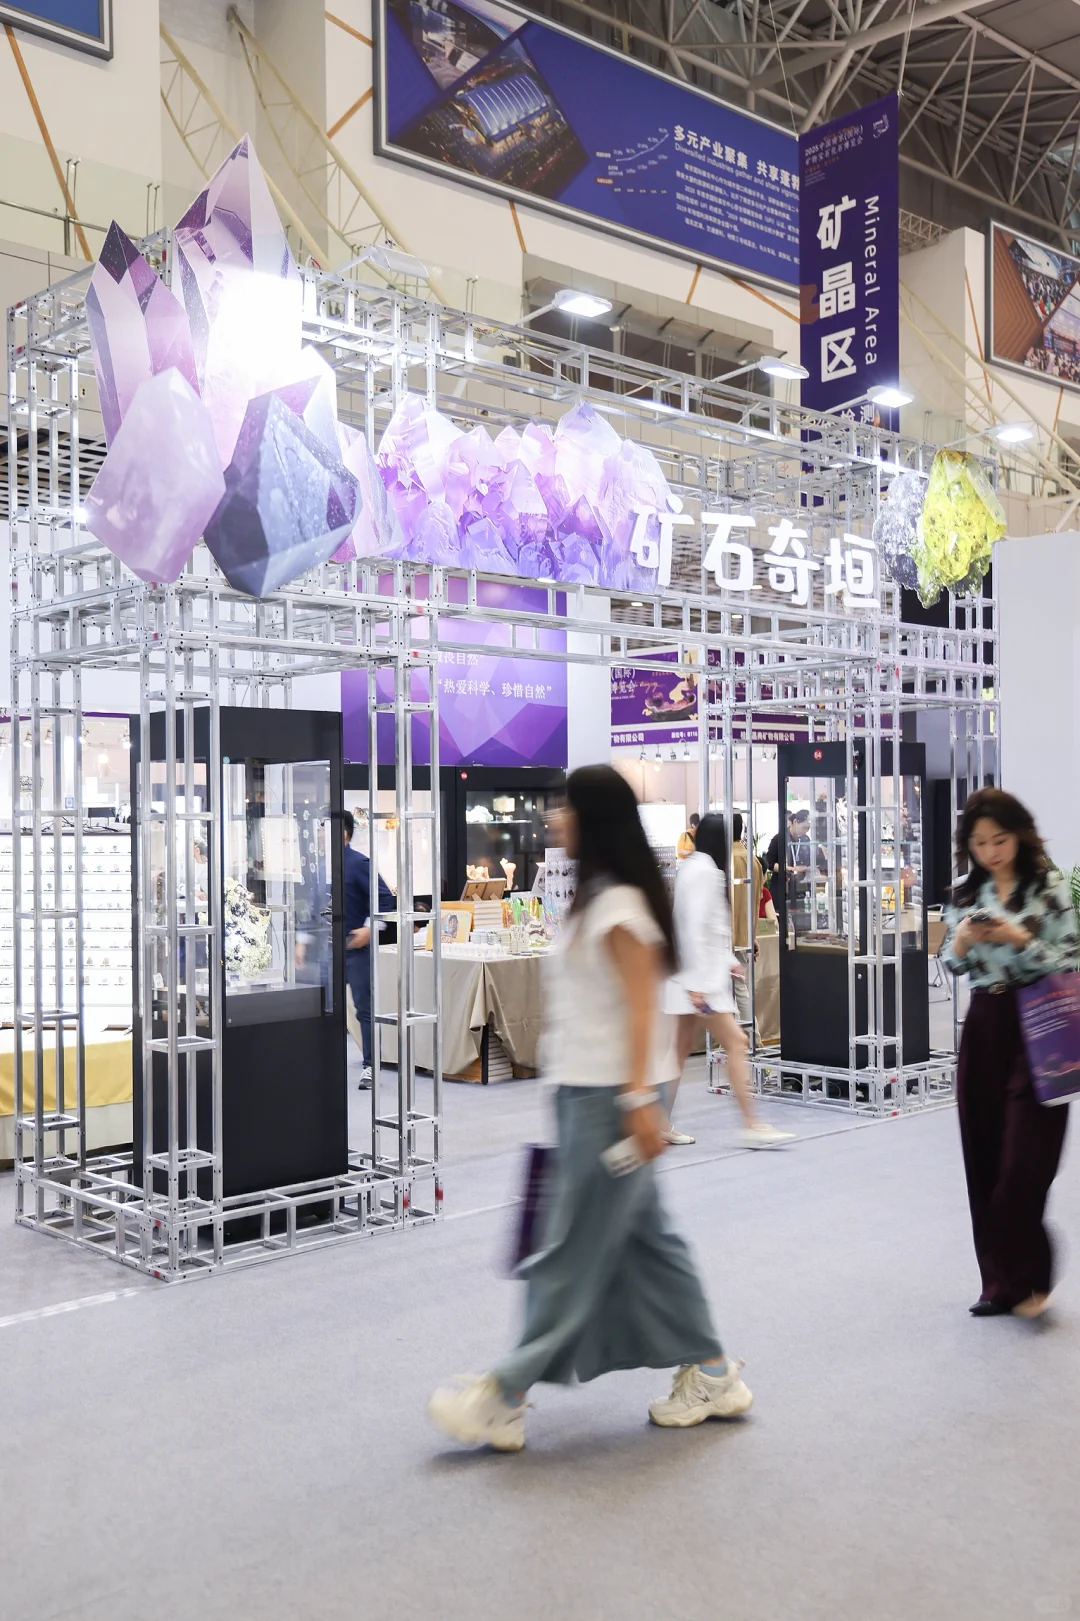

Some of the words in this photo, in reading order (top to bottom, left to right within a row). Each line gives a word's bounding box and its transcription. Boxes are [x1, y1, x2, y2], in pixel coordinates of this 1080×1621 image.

[674, 125, 747, 169] 多元产业聚集
[816, 195, 857, 383] 矿晶区
[864, 195, 881, 296] Mineral
[864, 306, 880, 365] Area
[629, 493, 881, 608] 矿石奇垣
